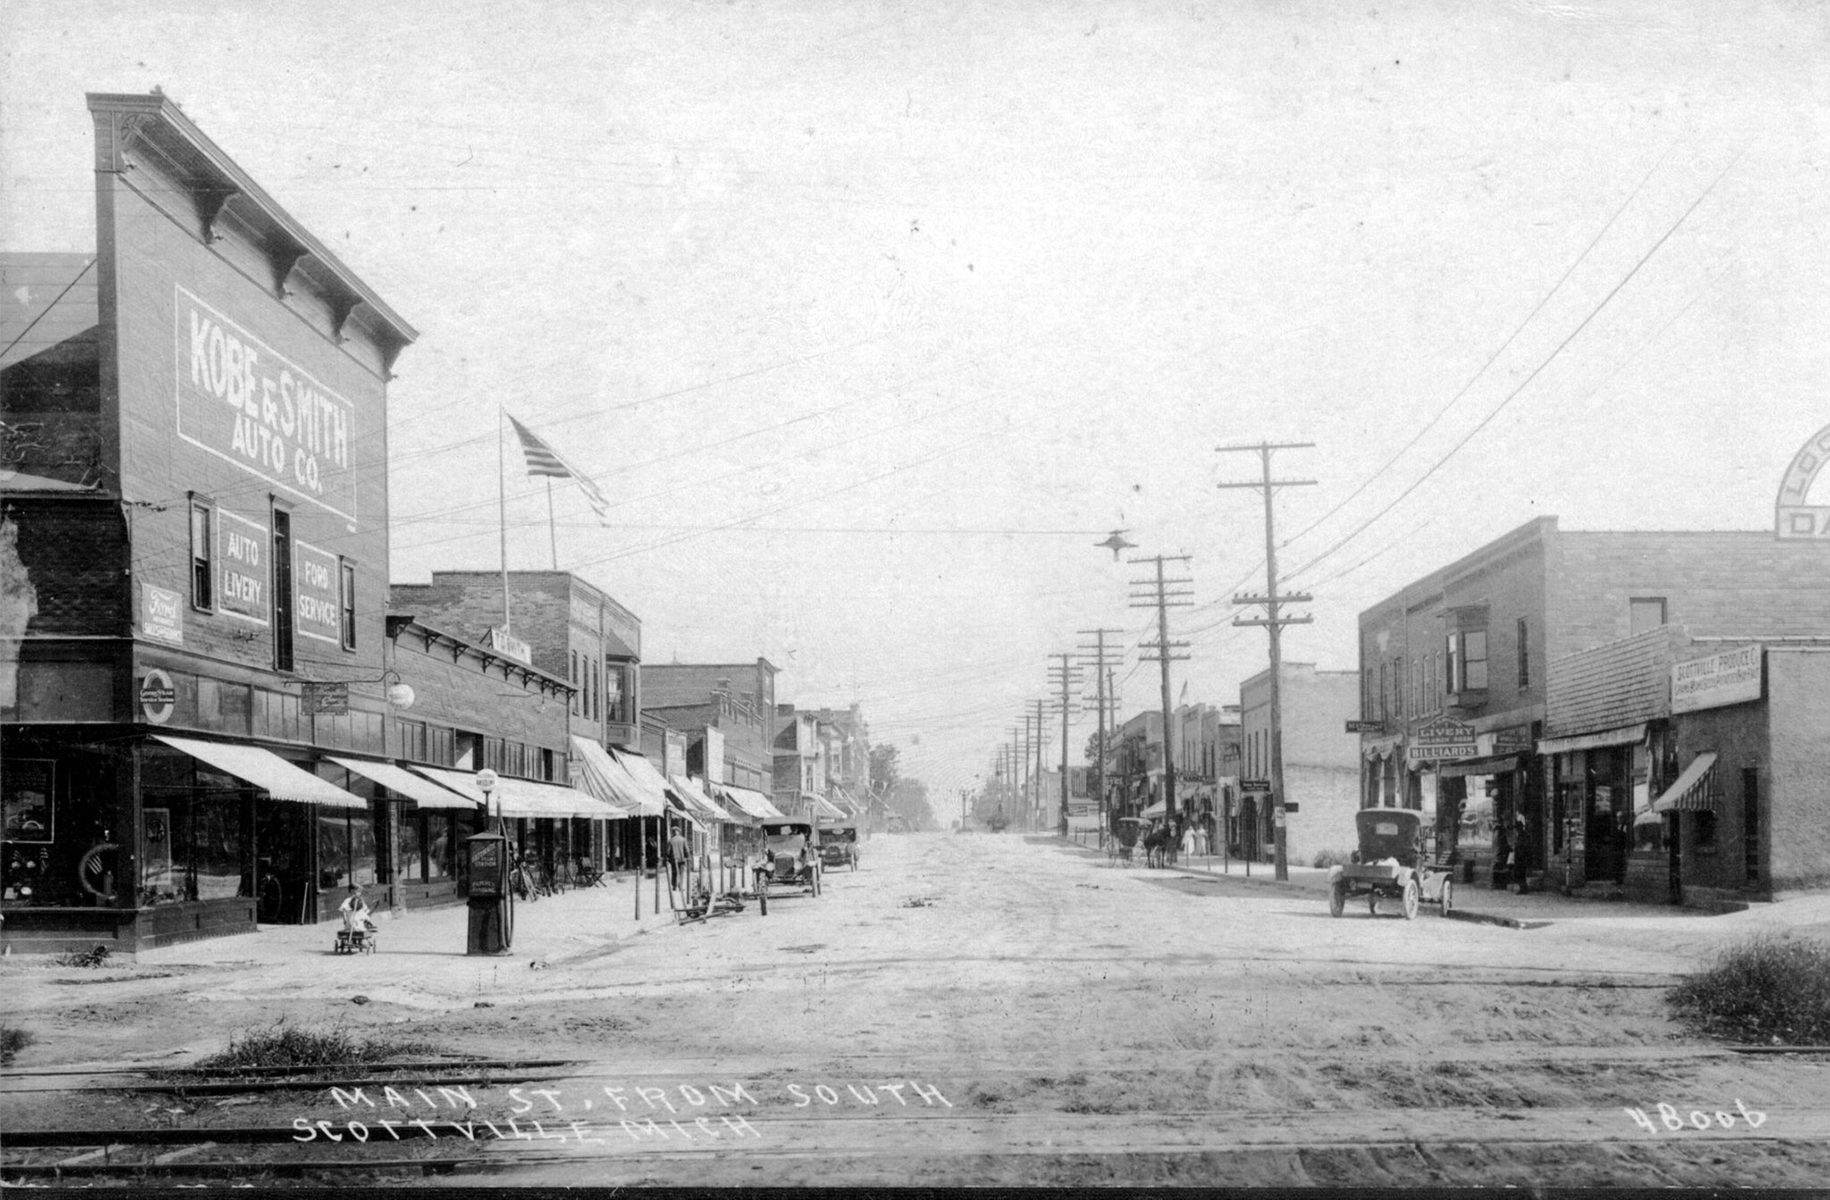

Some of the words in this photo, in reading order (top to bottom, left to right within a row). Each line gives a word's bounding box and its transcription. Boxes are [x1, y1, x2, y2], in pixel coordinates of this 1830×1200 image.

[190, 308, 259, 418] KOBE
[262, 377, 281, 426] &
[279, 370, 349, 469] SMITH
[232, 413, 285, 474] AUTO
[294, 447, 323, 494] CO.
[227, 532, 259, 567] AUTO
[224, 570, 262, 605] LIVERY
[305, 560, 329, 590] FORD
[149, 590, 177, 619] Ford
[299, 594, 336, 627] SERVICE
[1420, 726, 1474, 737] LIVERY
[1412, 746, 1475, 759] BILLIARDS
